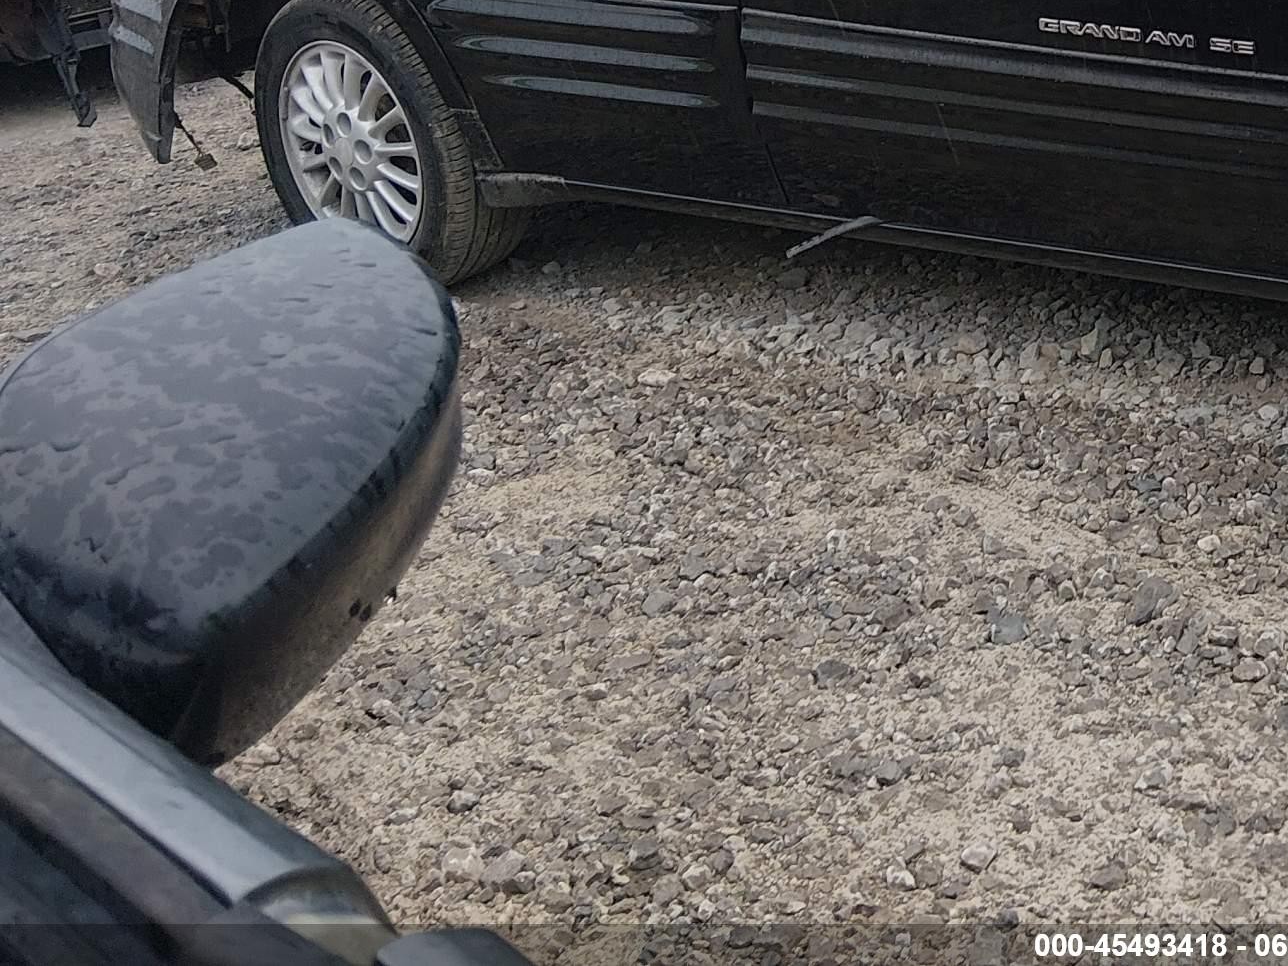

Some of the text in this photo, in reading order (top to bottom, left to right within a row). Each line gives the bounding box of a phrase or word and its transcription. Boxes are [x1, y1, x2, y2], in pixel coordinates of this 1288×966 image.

[1038, 17, 1255, 55] GRAND AM SE
